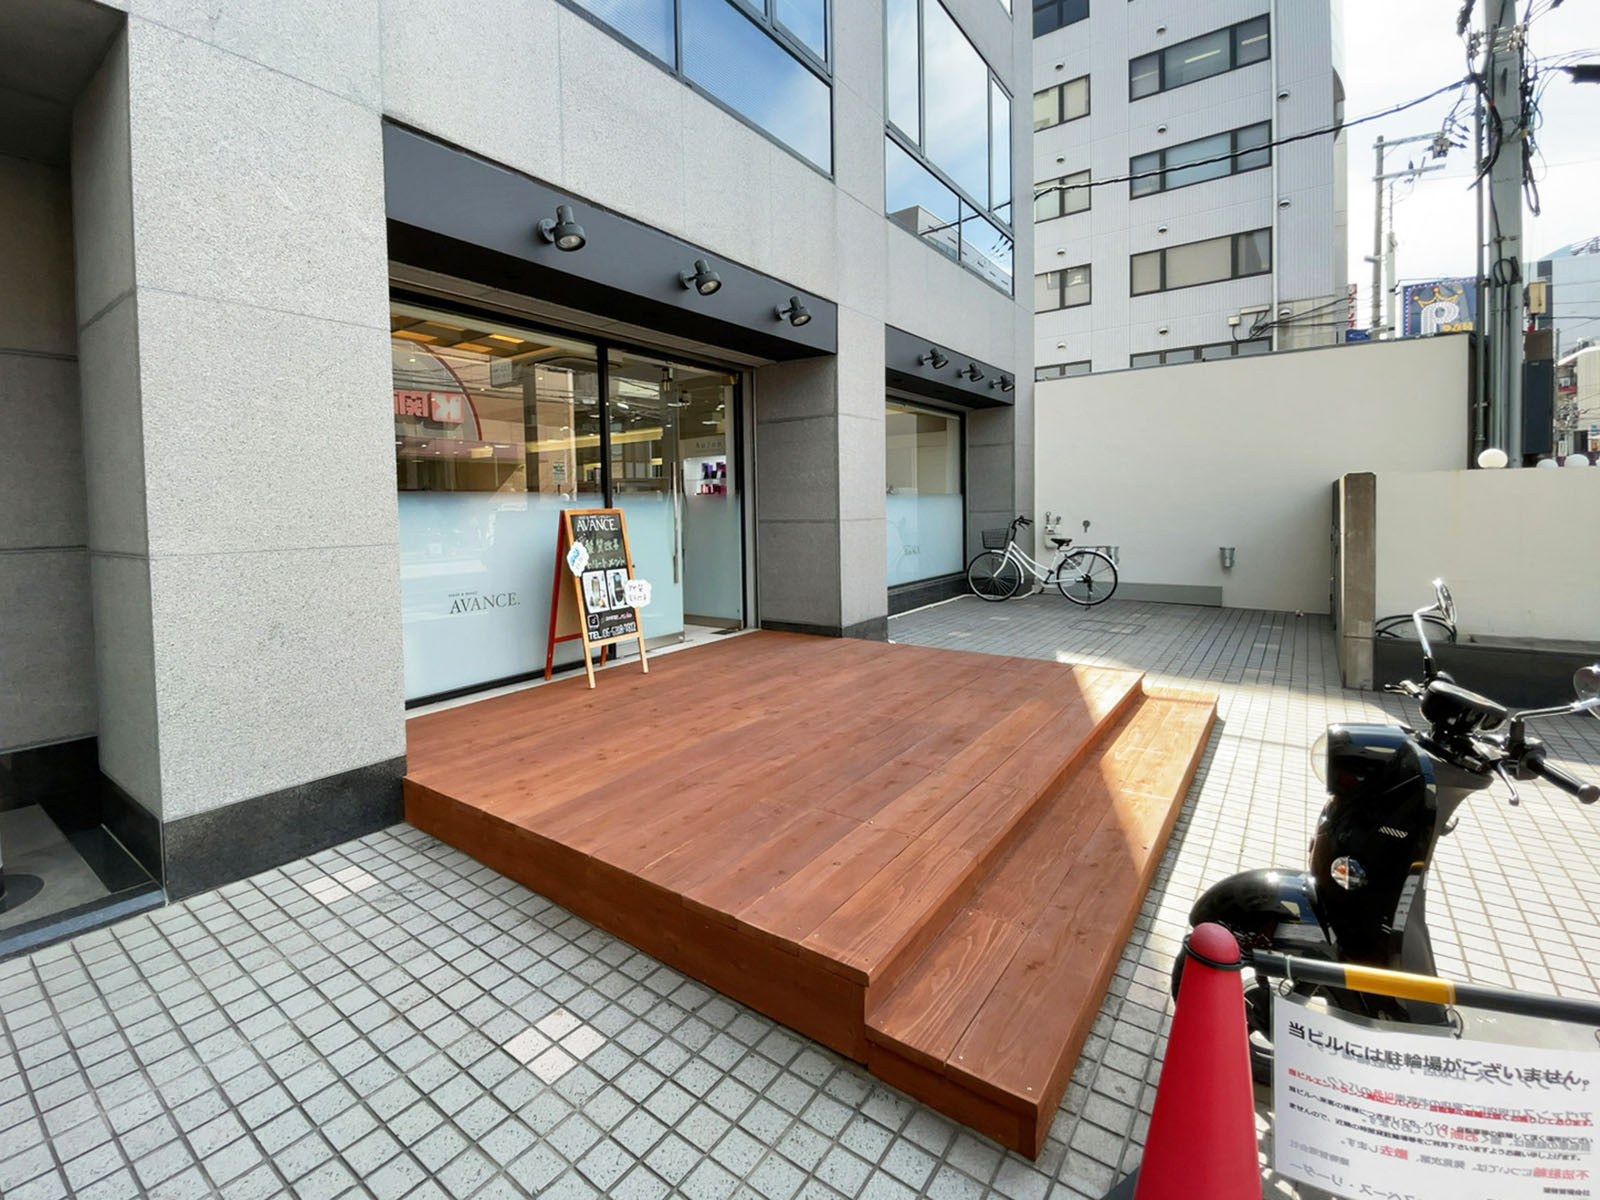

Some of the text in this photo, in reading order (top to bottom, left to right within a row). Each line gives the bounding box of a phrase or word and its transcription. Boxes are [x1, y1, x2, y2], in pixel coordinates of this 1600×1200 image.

[1288, 1021, 1591, 1088] 当ビルには駐輪場がございません。
